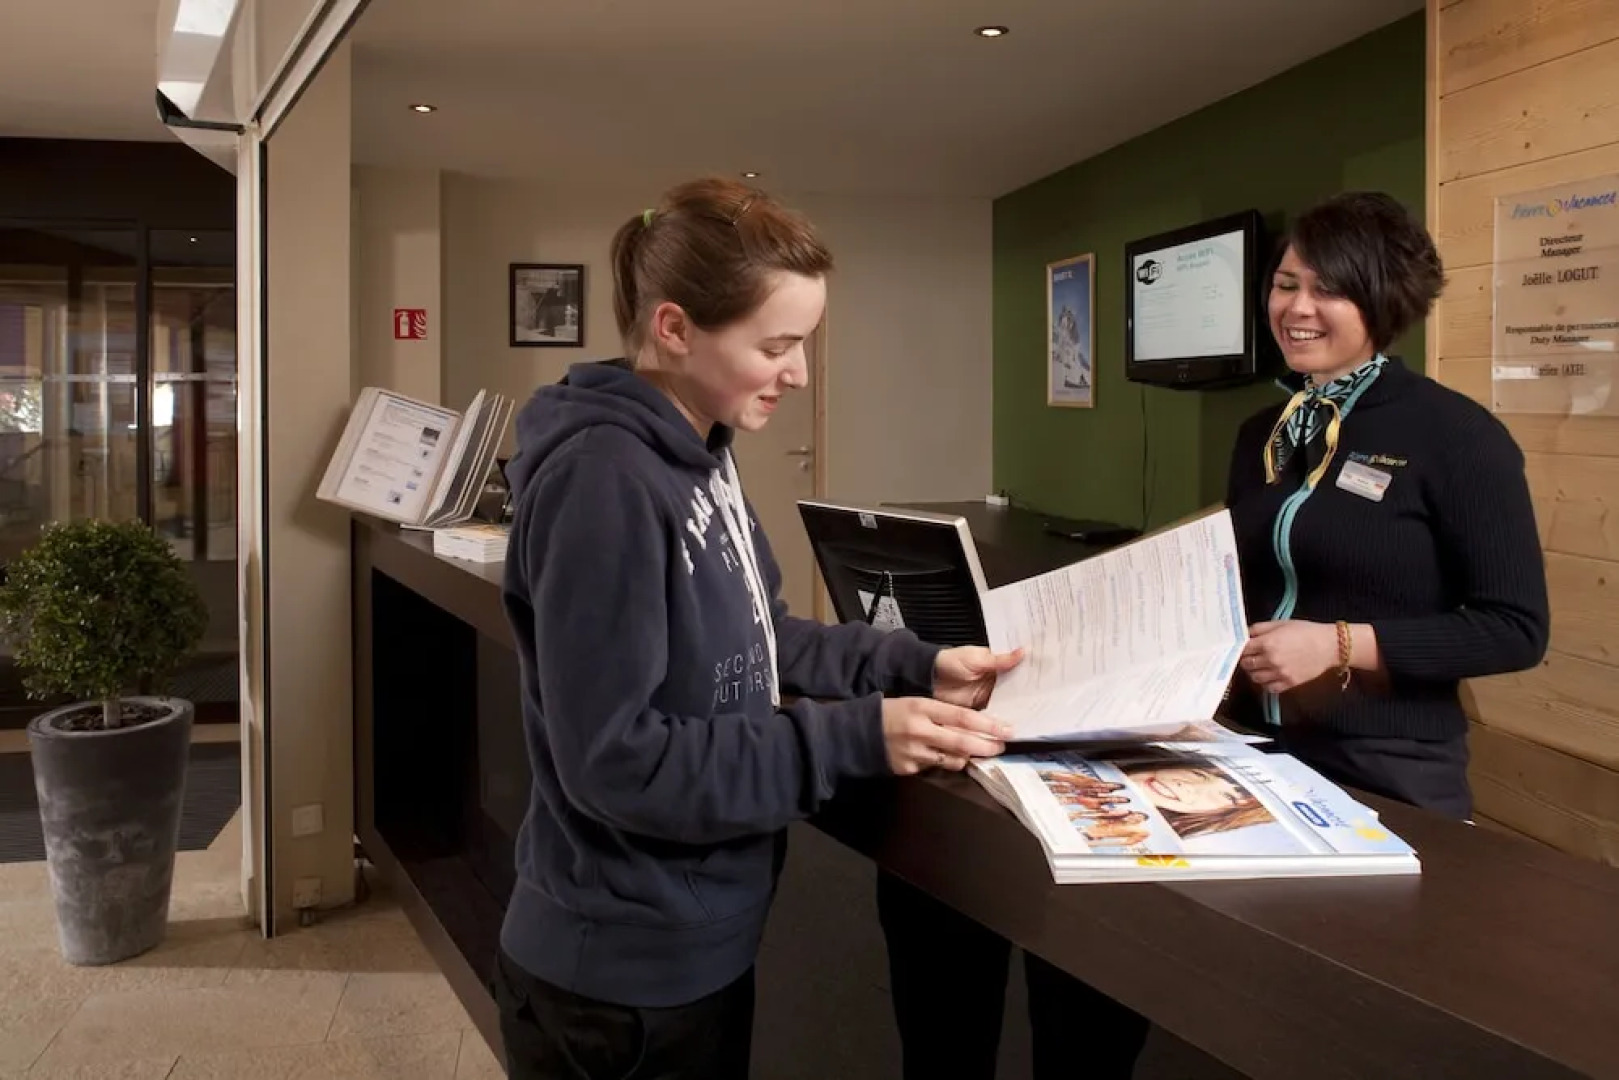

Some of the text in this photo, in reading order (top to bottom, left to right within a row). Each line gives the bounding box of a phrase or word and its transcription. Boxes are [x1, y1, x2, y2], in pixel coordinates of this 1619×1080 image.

[1540, 233, 1584, 247] Directeur
[1540, 245, 1582, 258] Manager
[1557, 266, 1599, 283] LOGUT
[1505, 323, 1554, 335] Responsable
[1555, 323, 1566, 333] de
[1530, 336, 1550, 346] Duty
[714, 642, 763, 683] SECND
